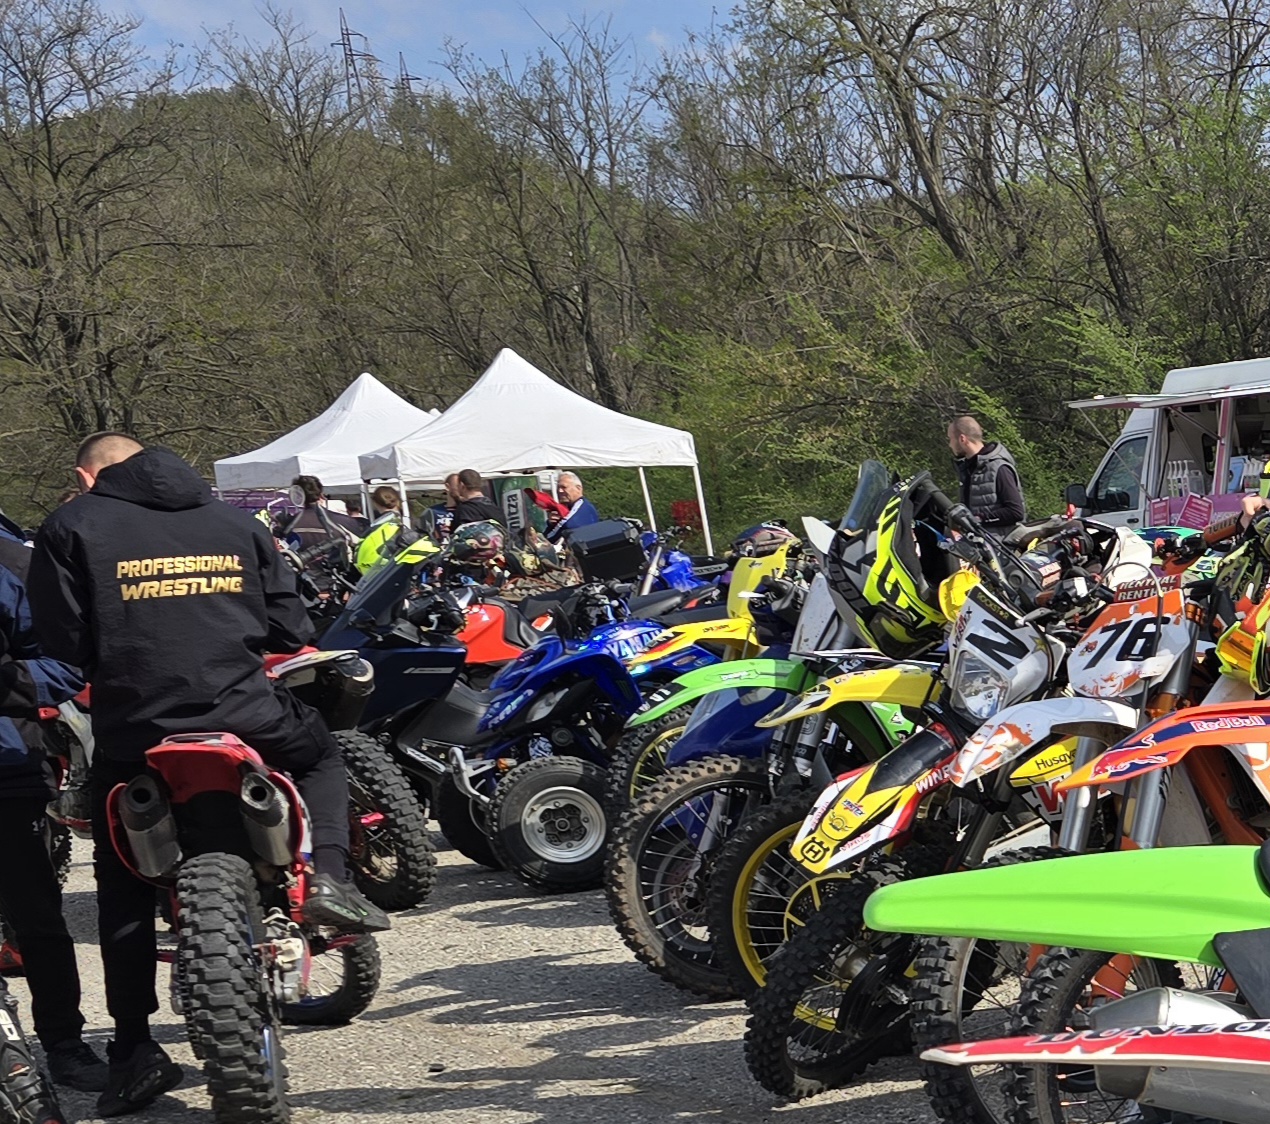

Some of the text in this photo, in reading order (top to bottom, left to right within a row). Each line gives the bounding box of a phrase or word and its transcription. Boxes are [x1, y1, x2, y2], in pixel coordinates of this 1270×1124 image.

[116, 554, 243, 579] PROFESSIONAL
[120, 576, 243, 601] WRESTLING
[1083, 616, 1171, 671] 76
[1191, 714, 1267, 733] Red Bull
